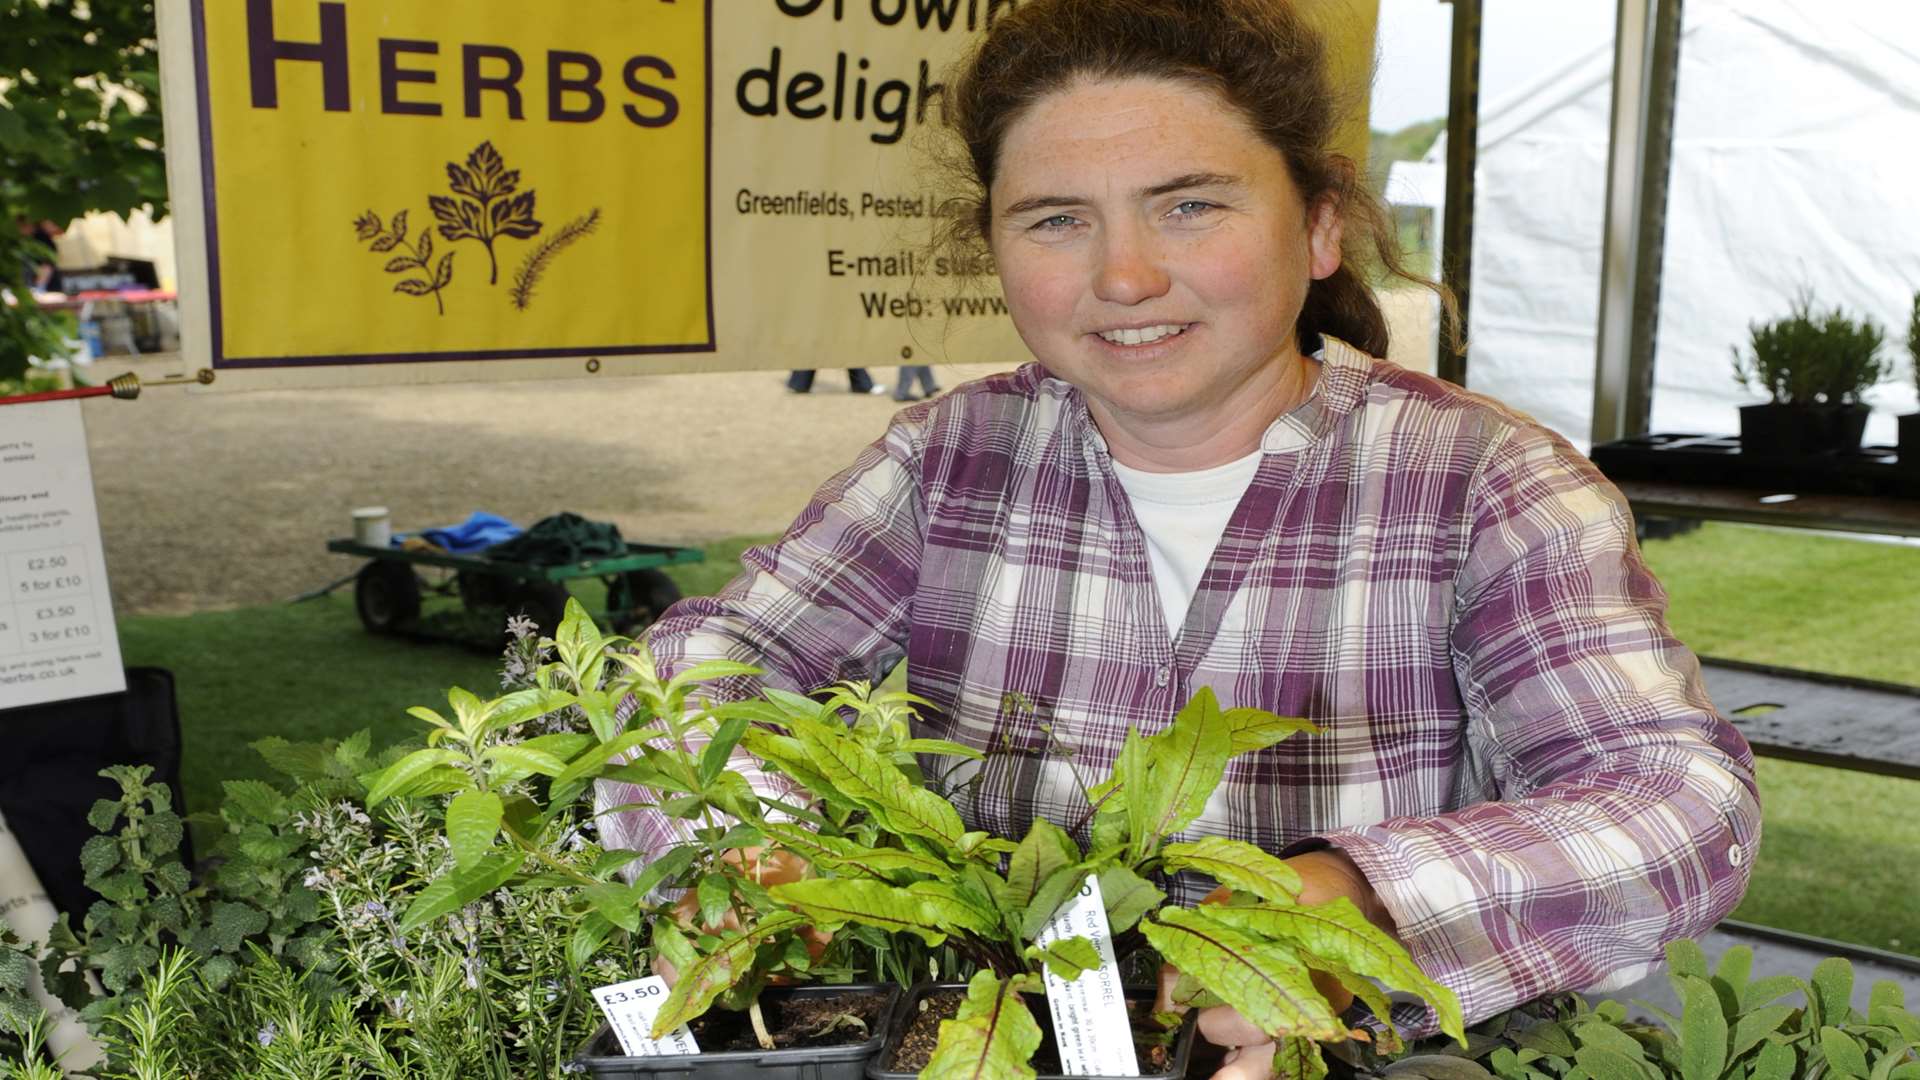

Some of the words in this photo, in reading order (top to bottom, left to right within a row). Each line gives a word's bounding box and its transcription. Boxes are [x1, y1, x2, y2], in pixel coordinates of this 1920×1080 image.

[246, 0, 680, 127] HERBS
[736, 188, 854, 221] Greenfields,
[861, 193, 922, 218] Pested
[827, 250, 924, 277] E-mail:
[861, 292, 933, 318] Web:
[28, 556, 67, 570] £2.50
[21, 581, 29, 592] 5
[33, 579, 52, 590] for
[55, 576, 82, 589] £10
[37, 605, 75, 620] £3.50
[29, 631, 39, 642] 3
[42, 629, 60, 641] for
[64, 625, 91, 639] £10
[1085, 910, 1098, 929] Red
[1098, 965, 1114, 1007] SORREL
[603, 985, 660, 1005] £3.50
